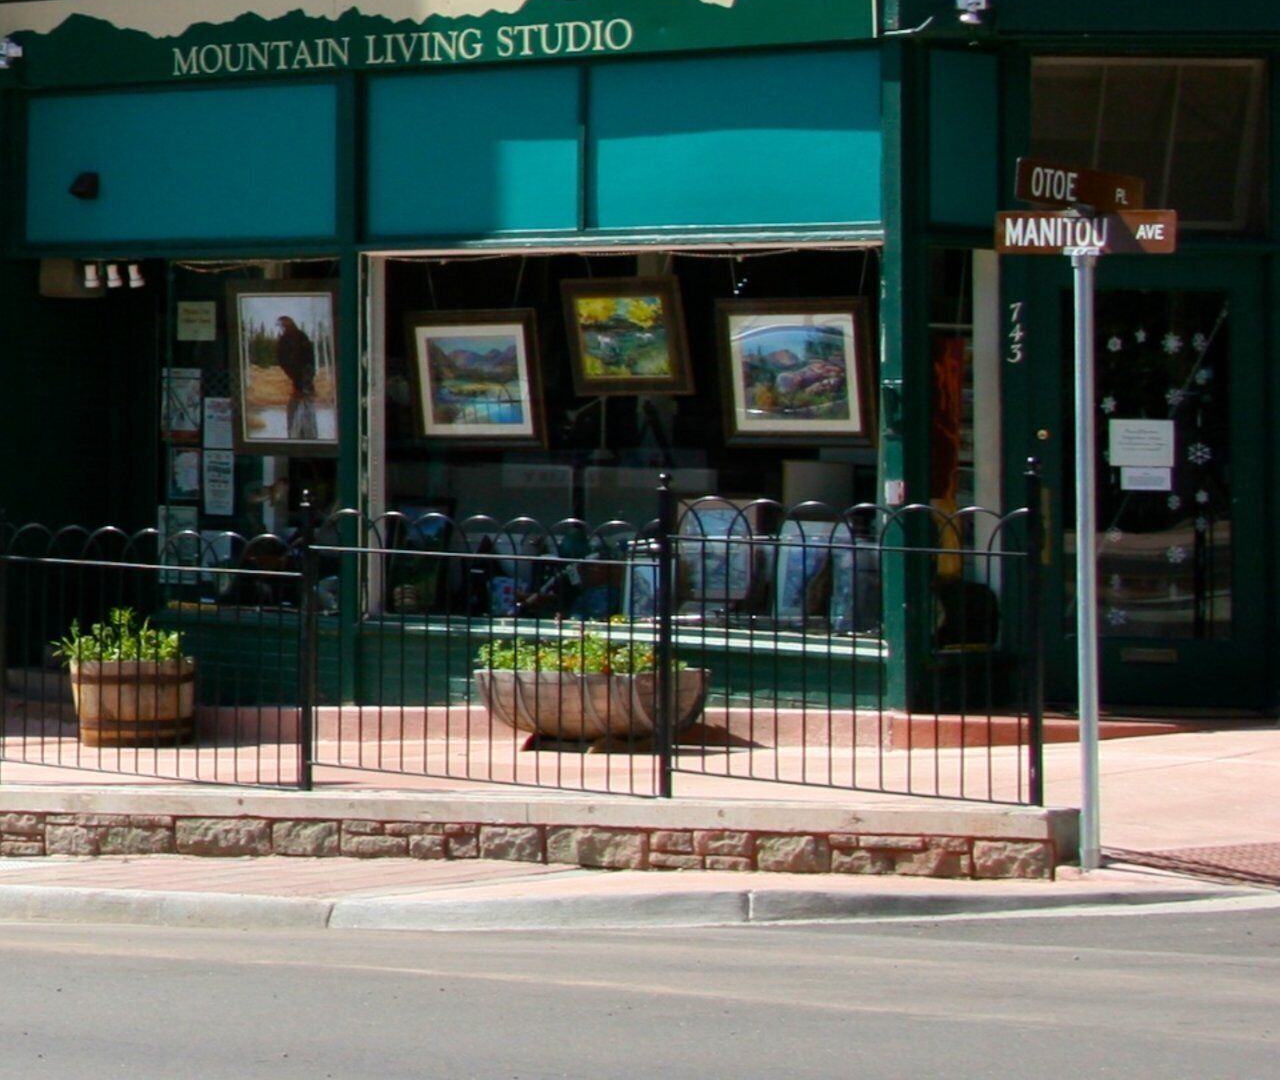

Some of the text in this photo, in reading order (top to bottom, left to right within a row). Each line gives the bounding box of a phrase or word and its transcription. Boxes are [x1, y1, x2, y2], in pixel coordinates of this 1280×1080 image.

[172, 17, 634, 76] MOUNTAIN LIVING STUDIO
[1031, 166, 1128, 205] OTOE PL
[1005, 217, 1165, 247] MANITOU AVE
[1006, 301, 1024, 363] 743
